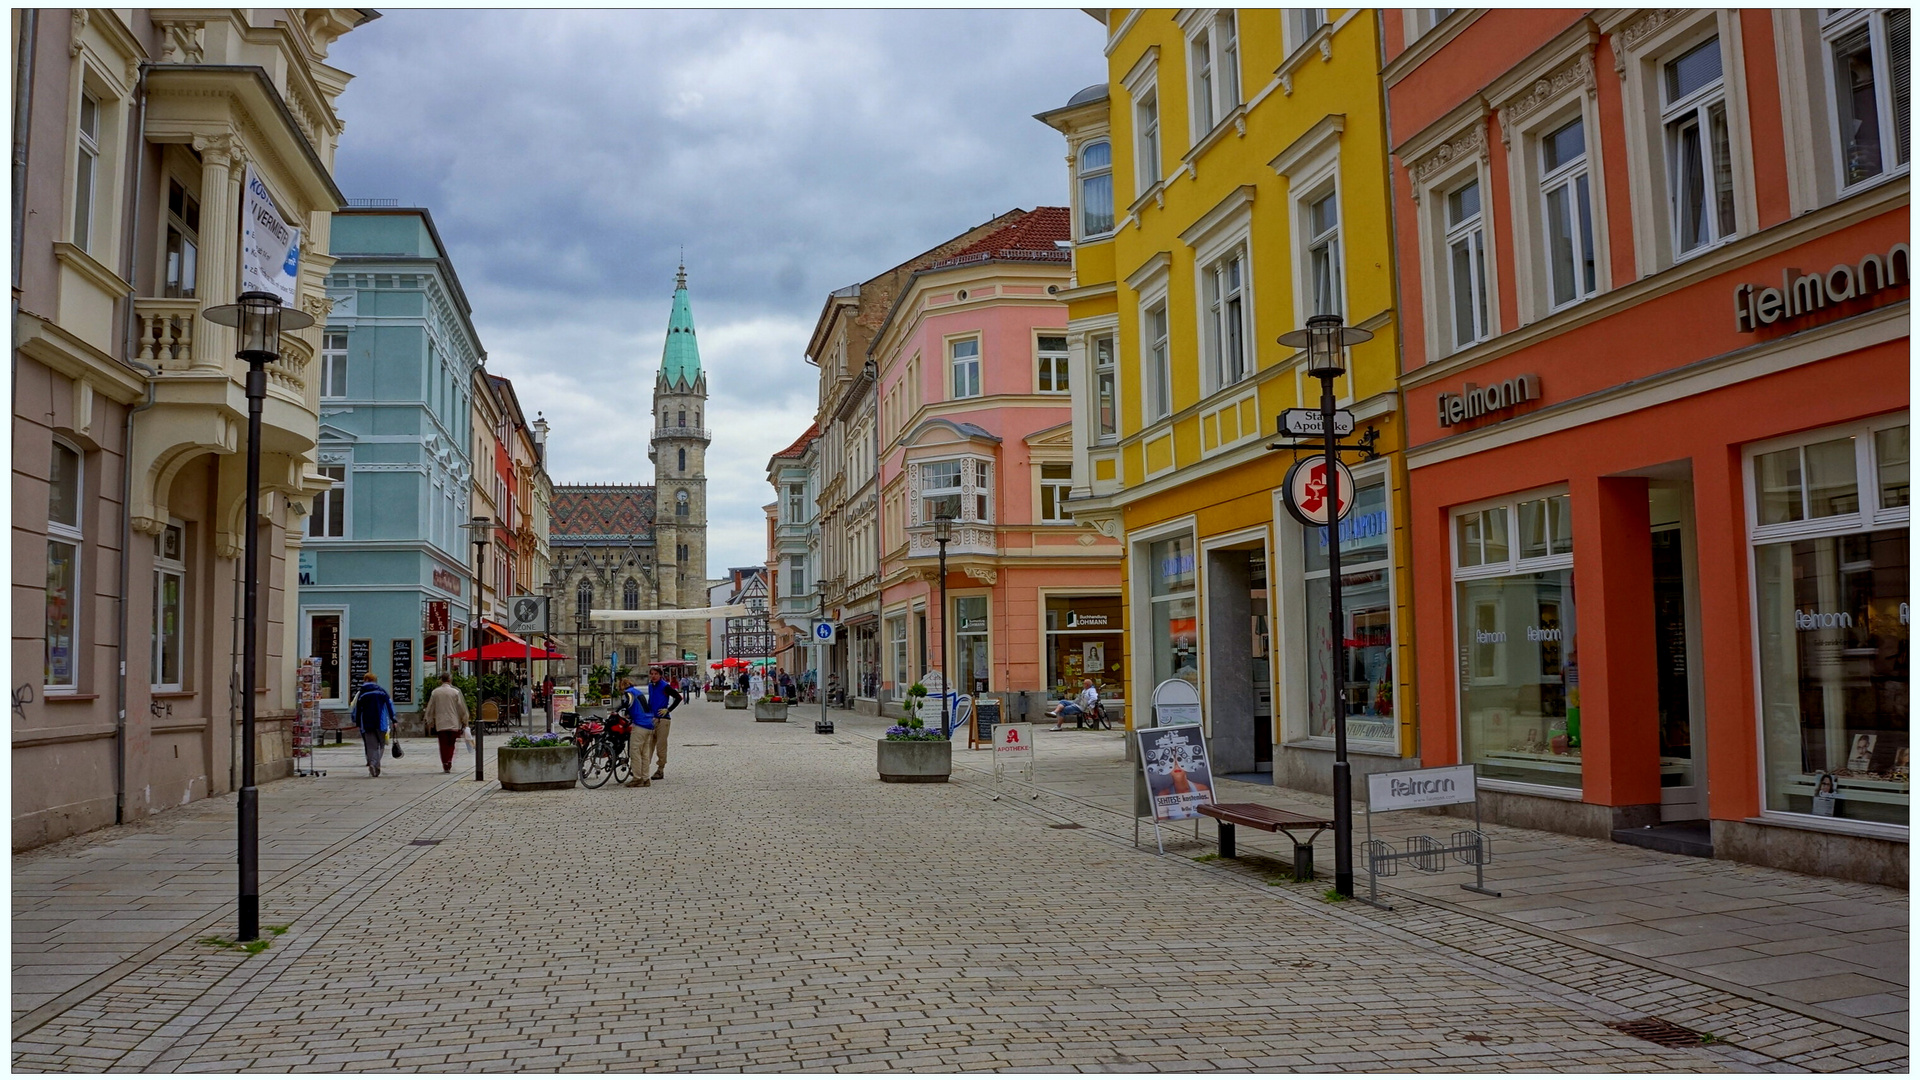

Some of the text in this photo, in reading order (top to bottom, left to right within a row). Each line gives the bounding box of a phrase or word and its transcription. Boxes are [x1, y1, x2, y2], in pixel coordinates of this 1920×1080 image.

[1734, 242, 1910, 333] fielmann
[1437, 372, 1541, 429] fielmann
[517, 623, 537, 631] ZONE
[1795, 608, 1853, 631] fielmann
[1476, 628, 1507, 644] fielmann
[1527, 625, 1562, 641] fielmann
[331, 626, 339, 666] BISTRO
[1390, 776, 1456, 798] fielmann
